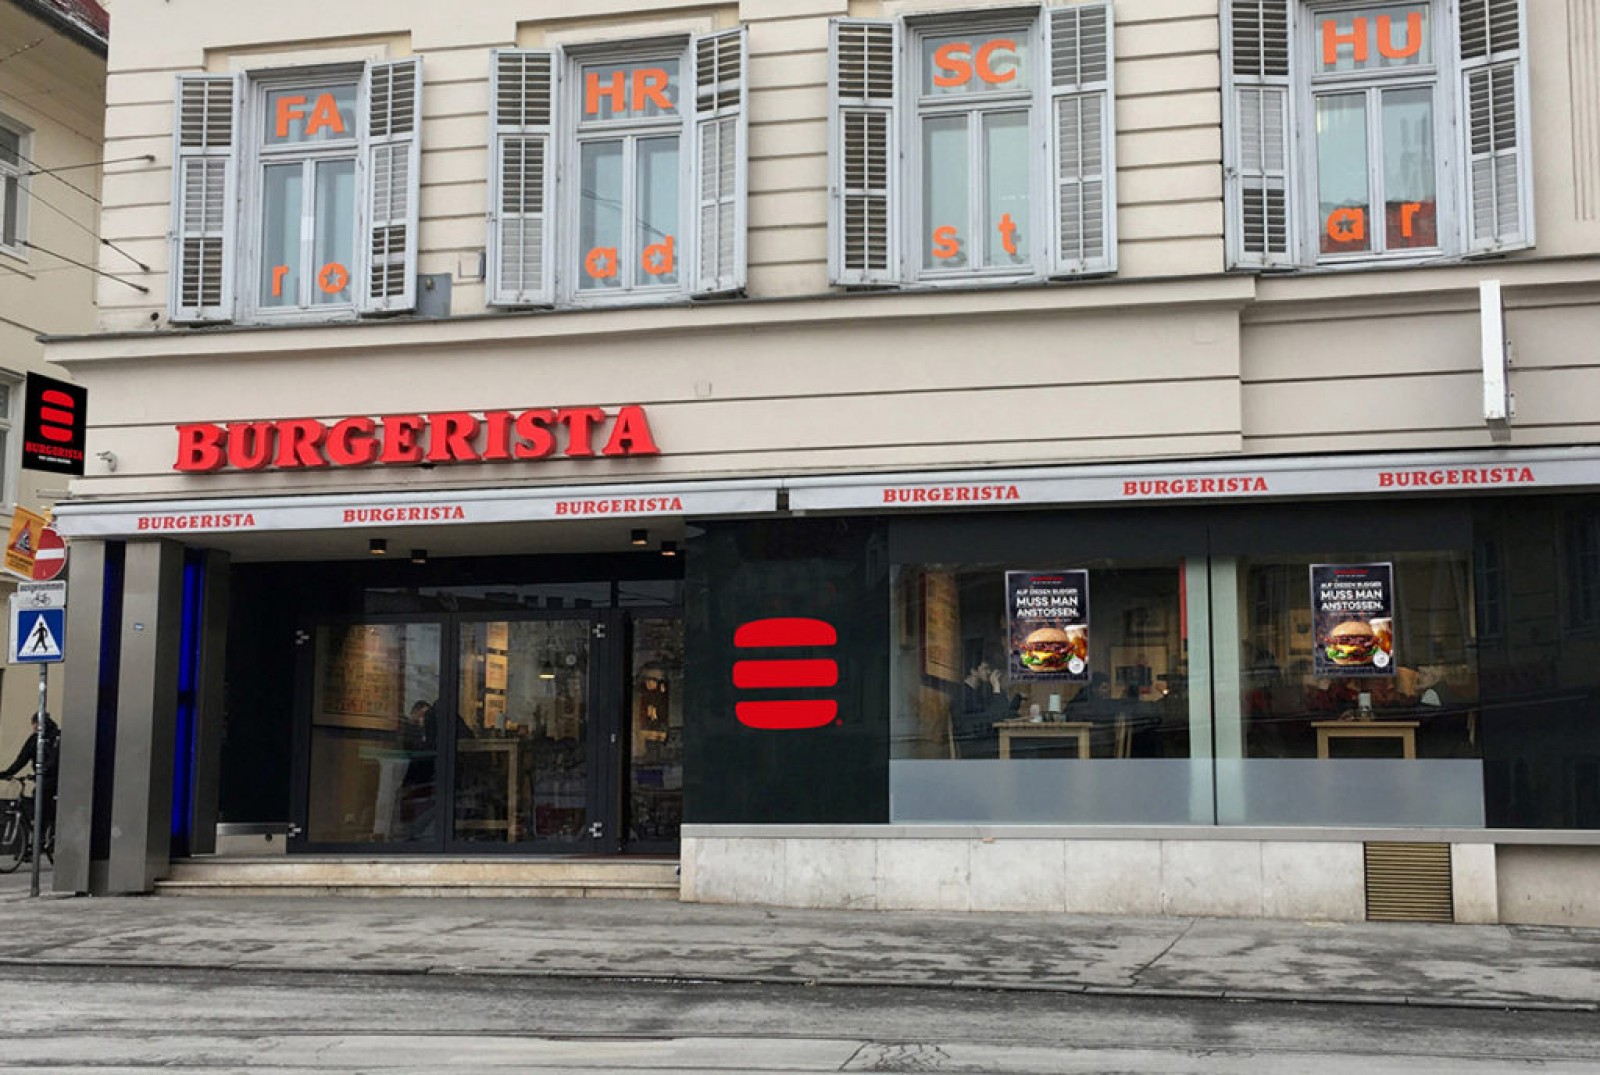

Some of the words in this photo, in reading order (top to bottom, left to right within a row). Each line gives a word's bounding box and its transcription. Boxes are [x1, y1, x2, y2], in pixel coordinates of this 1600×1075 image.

[1323, 13, 1422, 64] HU
[934, 40, 1015, 87] SC
[586, 68, 672, 113] HR
[276, 94, 344, 136] FA
[173, 404, 661, 473] BURGERISTA
[1380, 466, 1535, 487] BURGERISTA
[884, 485, 1020, 503] BURGERISTA
[1124, 477, 1268, 496] BURGERISTA
[343, 505, 465, 524] BURGERISTA
[555, 497, 683, 515] BURGERISTA
[137, 513, 256, 531] BURGERISTA
[1016, 596, 1049, 607] MUSS
[1051, 596, 1079, 606] MAN
[1321, 590, 1353, 600] MUSS
[1356, 589, 1383, 600] MAN
